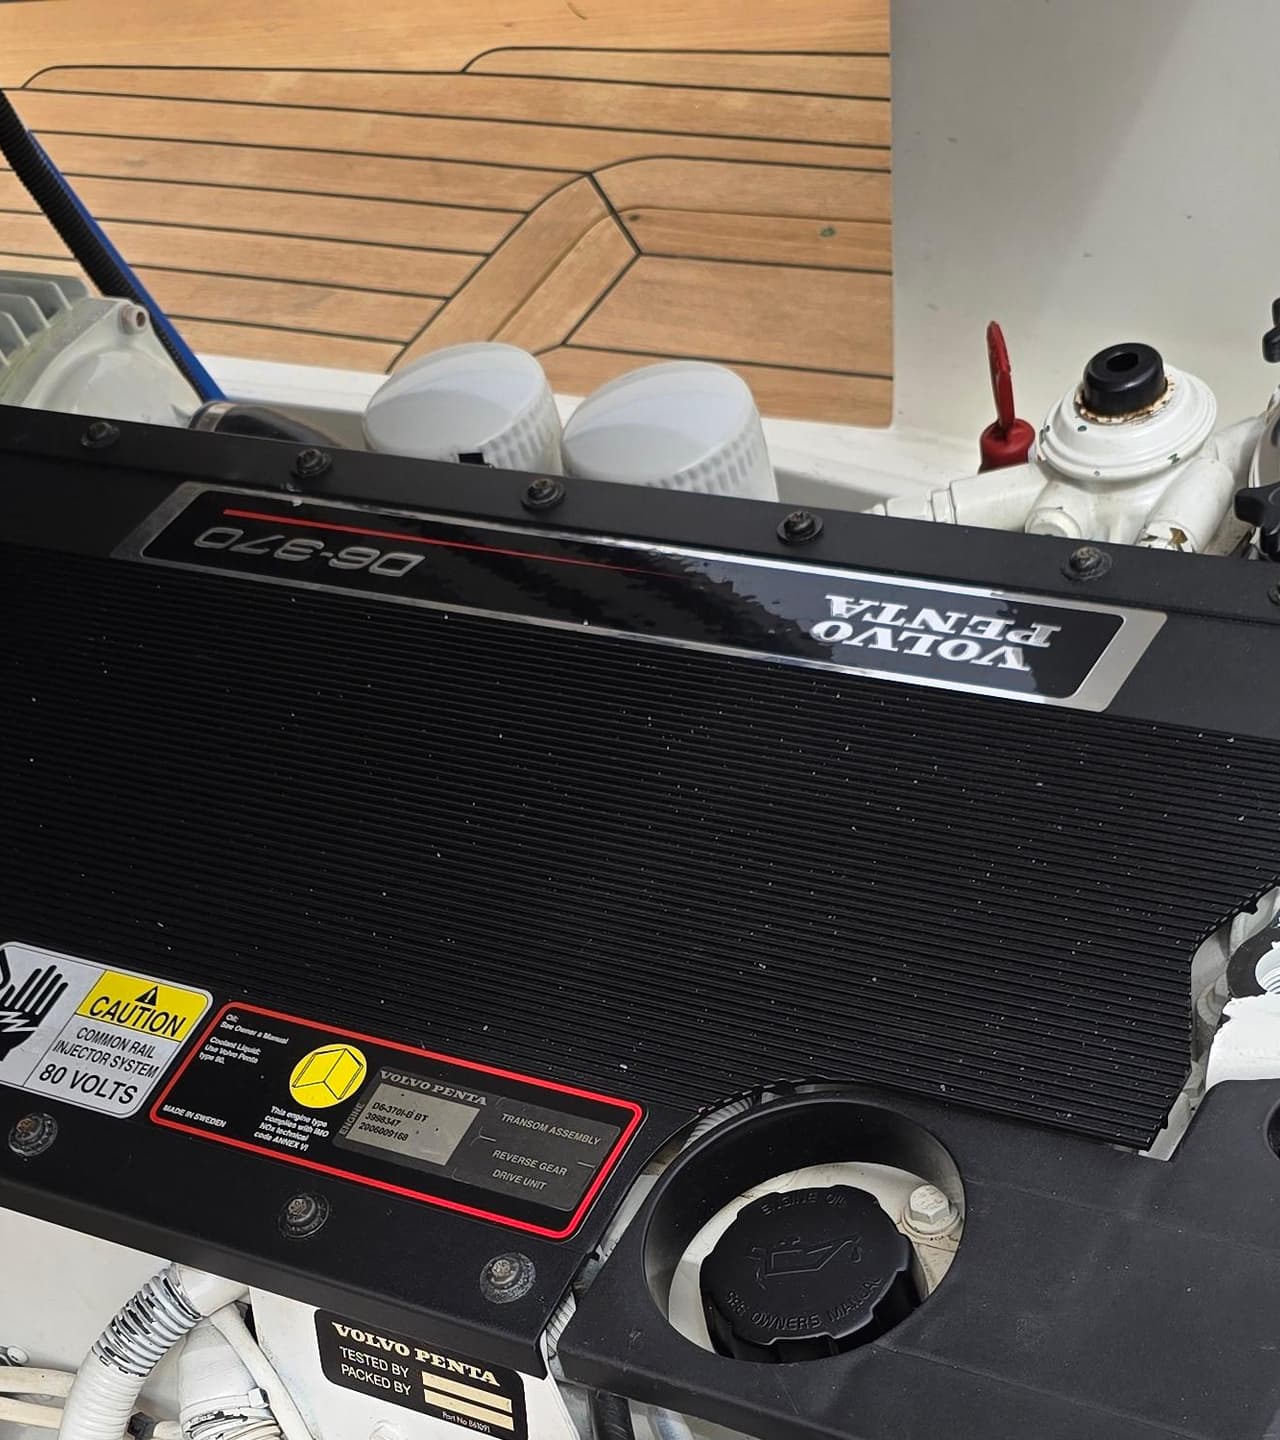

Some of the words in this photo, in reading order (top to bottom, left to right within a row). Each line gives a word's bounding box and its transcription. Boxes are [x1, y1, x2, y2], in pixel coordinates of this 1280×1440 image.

[194, 527, 425, 576] D6-370
[825, 594, 1062, 647] PENTA
[810, 620, 1031, 671] VOLVO
[90, 996, 186, 1037] CAUTION
[76, 1028, 131, 1051] COMMON
[130, 1042, 155, 1059] RAIL
[209, 1036, 237, 1049] Coolant
[220, 1022, 234, 1030] See
[263, 1032, 289, 1044] Manual
[53, 1040, 111, 1068] INJECTOR
[110, 1056, 159, 1078] SYSTEM
[204, 1044, 219, 1052] Use
[220, 1048, 238, 1058] Volvo
[238, 1053, 258, 1064] Penta
[39, 1064, 67, 1084] 80
[70, 1070, 138, 1104] VOLTS
[380, 1070, 431, 1091] VOLVO
[430, 1085, 487, 1106] PENTA
[163, 1104, 185, 1118] MADE
[185, 1110, 194, 1119] IN
[194, 1113, 226, 1128] SWEDEN
[259, 1122, 276, 1132] NOx
[276, 1126, 310, 1141] technical
[264, 1115, 296, 1129] complies
[297, 1122, 313, 1133] with
[313, 1126, 330, 1138] IMO
[271, 1106, 287, 1116] This
[286, 1110, 310, 1122] engine
[312, 1116, 328, 1128] type
[339, 1103, 364, 1136] ENGINE
[502, 1113, 547, 1132] TRANSOM
[548, 1124, 602, 1145] ASSEMBLY
[254, 1131, 272, 1142] code
[272, 1136, 300, 1149] ANNEX
[493, 1150, 538, 1168] REVERSE
[538, 1162, 568, 1176] GEAR
[493, 1169, 522, 1184] DRIVE
[523, 1176, 547, 1190] UNIT
[752, 1312, 820, 1330] OWNERS
[332, 1322, 410, 1356] VOLVO
[414, 1348, 500, 1386] PENTA
[340, 1346, 388, 1370] TESTED
[392, 1364, 410, 1378] BY
[341, 1364, 390, 1389] PACKED
[394, 1381, 412, 1395] BY
[442, 1411, 456, 1420] Part
[456, 1416, 468, 1426] No
